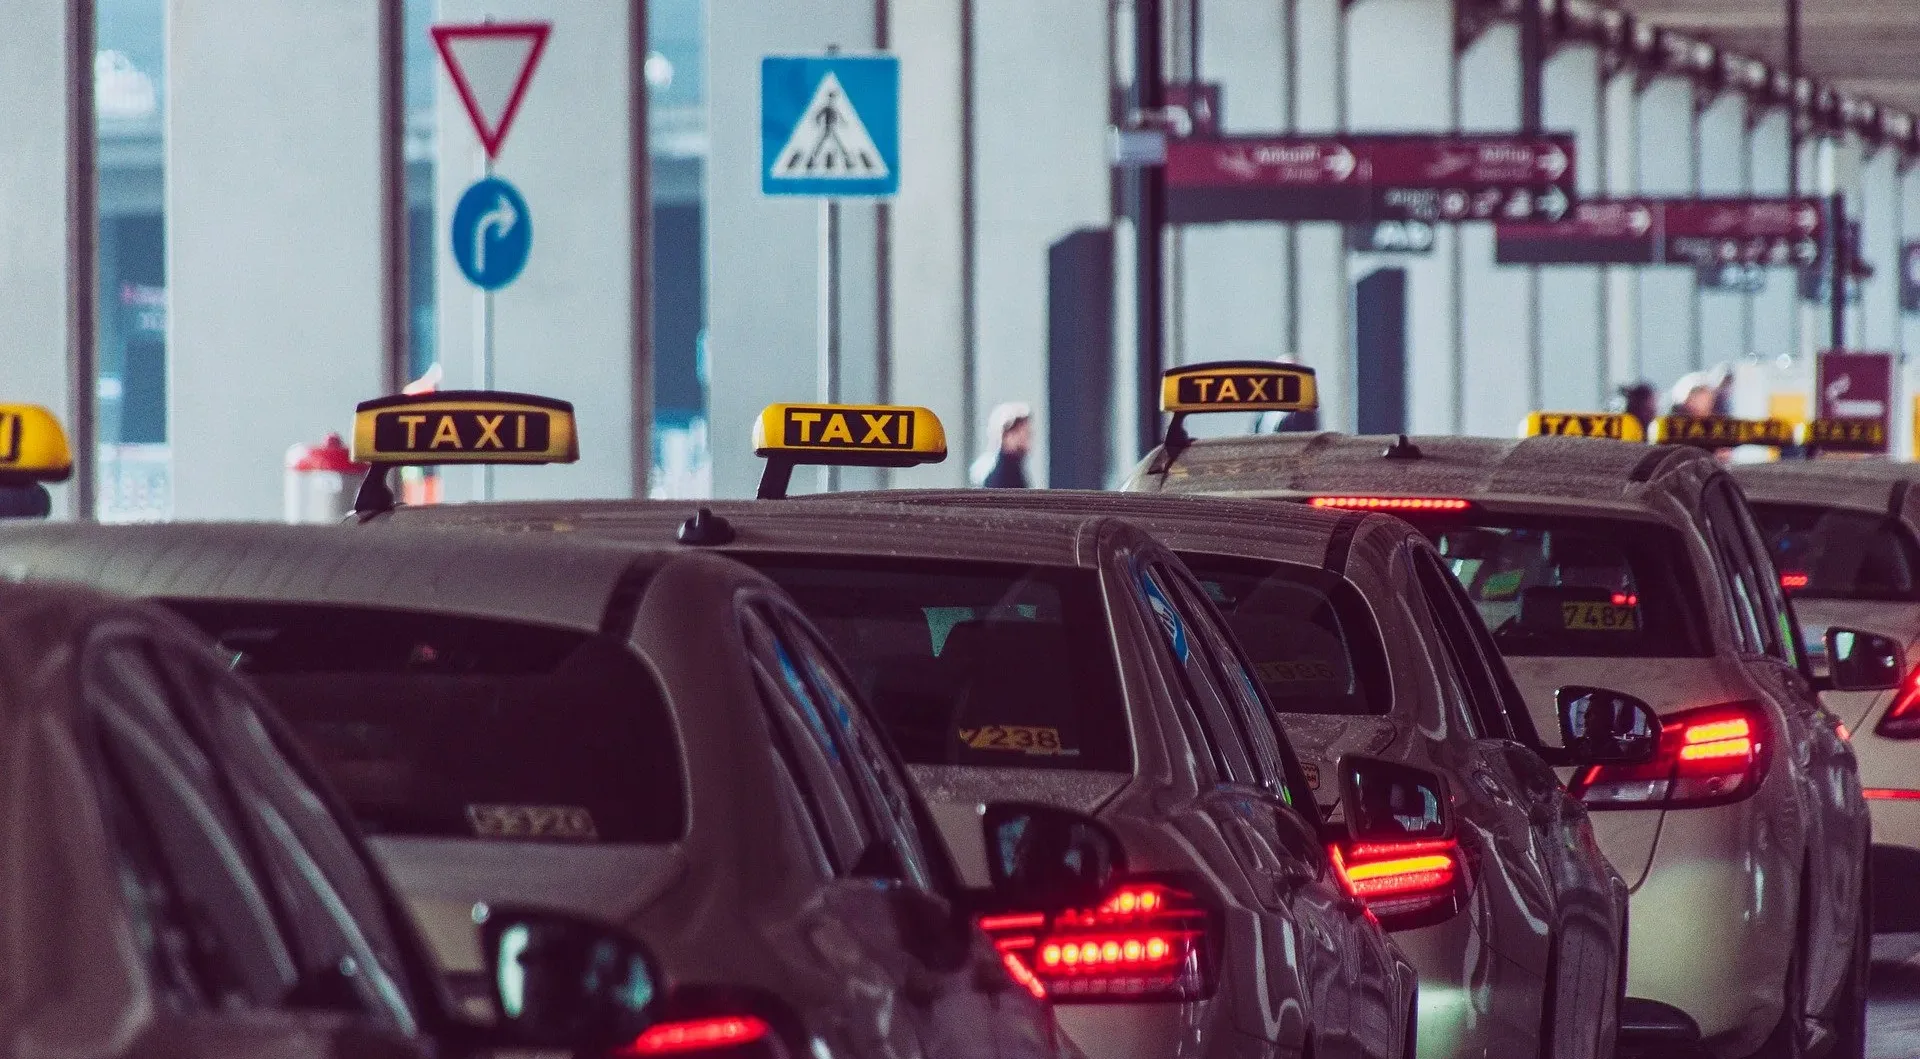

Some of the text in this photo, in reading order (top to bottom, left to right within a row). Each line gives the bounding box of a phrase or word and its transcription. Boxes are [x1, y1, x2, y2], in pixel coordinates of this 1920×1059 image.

[1193, 378, 1284, 402] TAXI
[398, 414, 526, 449] TAXI
[791, 412, 908, 445] TAXI
[1545, 415, 1619, 439] TAXI
[1565, 605, 1631, 627] 7487
